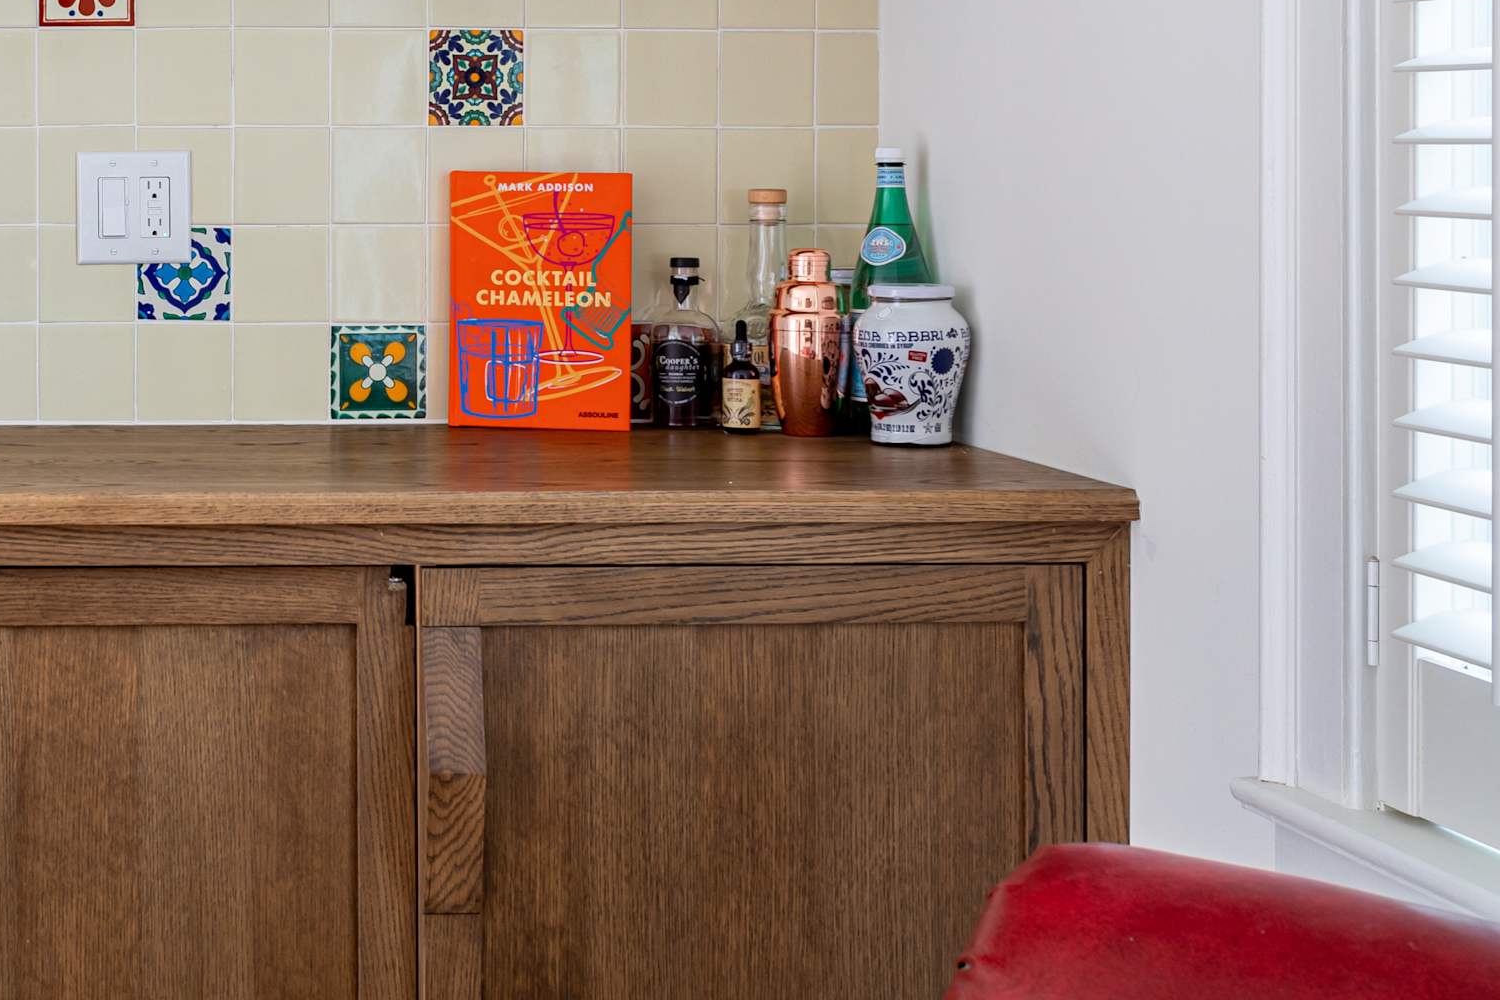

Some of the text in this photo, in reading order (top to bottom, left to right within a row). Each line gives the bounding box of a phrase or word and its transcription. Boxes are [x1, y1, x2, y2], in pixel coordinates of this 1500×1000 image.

[498, 183, 593, 192] MARK ADDISON
[491, 269, 596, 287] COCKTAIL
[476, 290, 612, 307] CHAMELEON
[888, 331, 944, 342] FABBRI
[659, 355, 698, 366] COOPER'S
